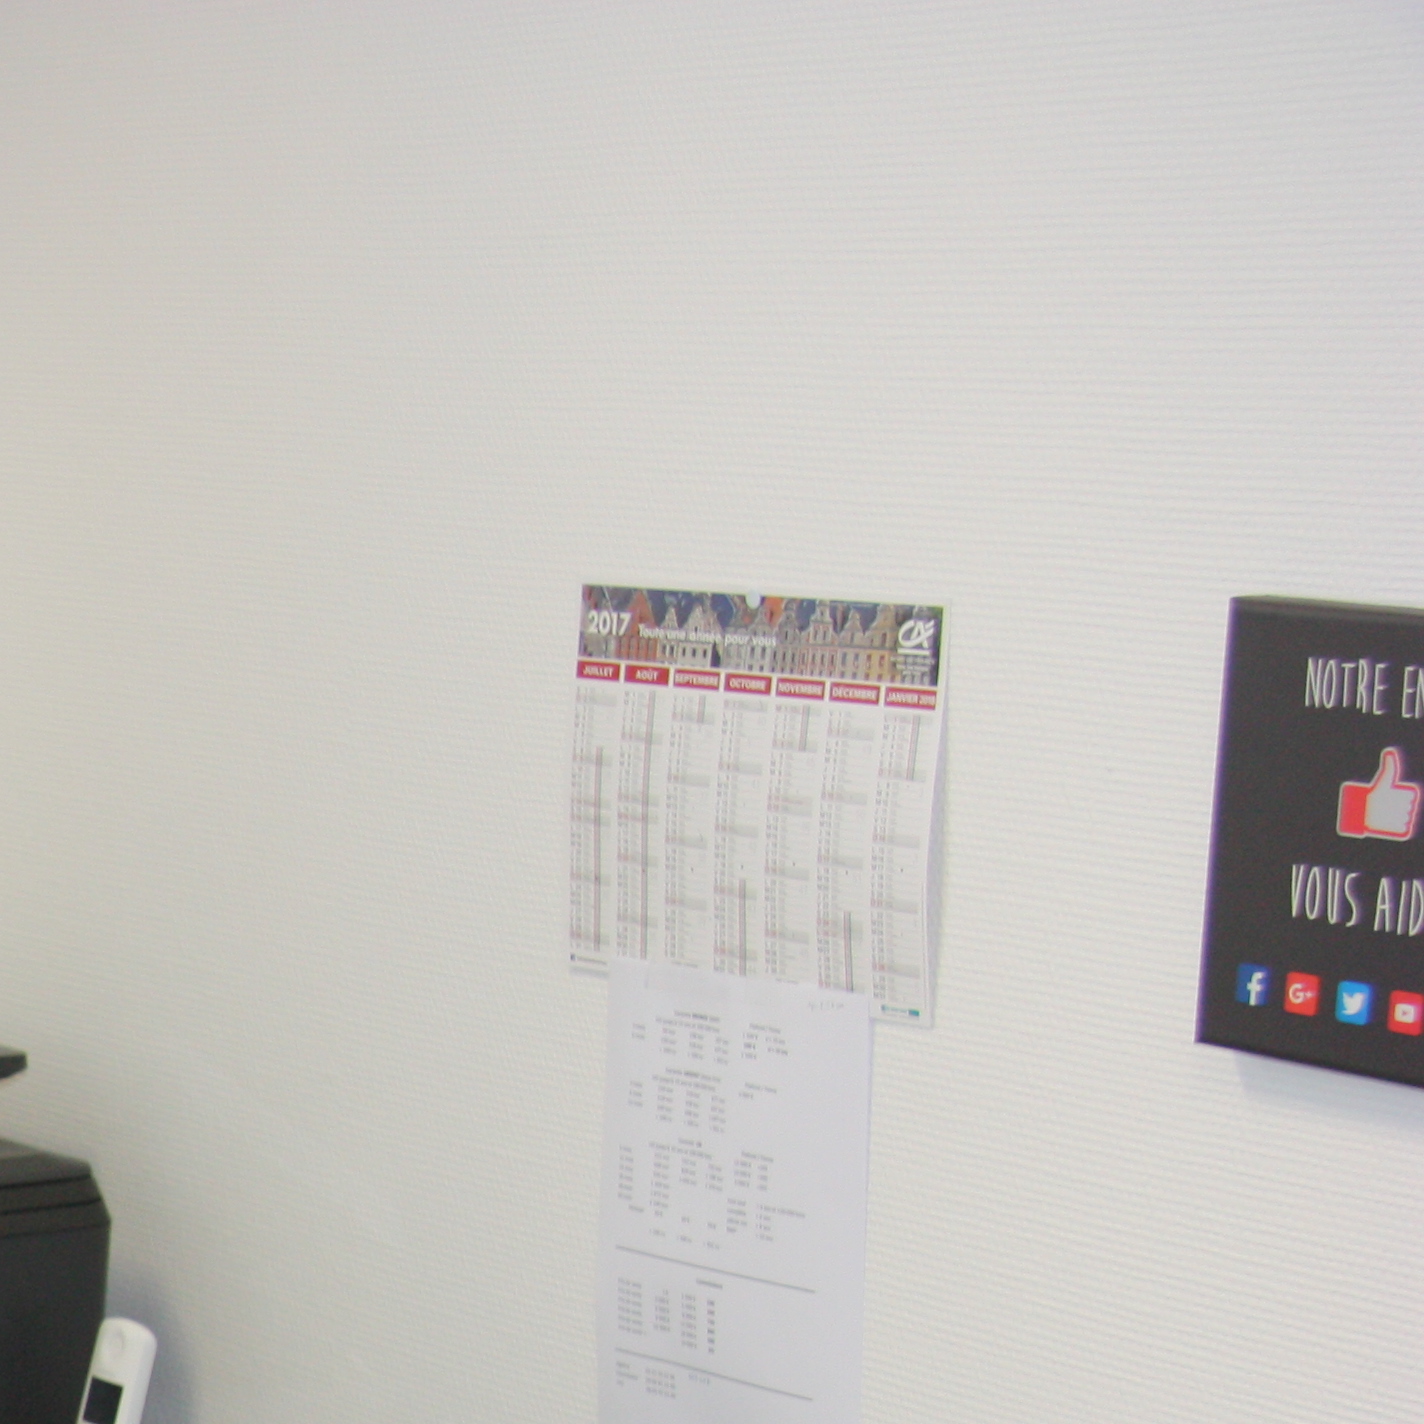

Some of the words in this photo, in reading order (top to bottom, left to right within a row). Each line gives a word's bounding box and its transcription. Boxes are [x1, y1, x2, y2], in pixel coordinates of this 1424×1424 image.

[587, 610, 632, 637] 2017
[724, 633, 749, 646] pour
[751, 635, 777, 647] vous
[583, 665, 614, 678] JUILLET
[675, 673, 719, 686] SEPTEMBRE
[729, 679, 767, 692] OCTOBRE
[778, 683, 823, 696] NOVEMBRE
[887, 692, 918, 704] JANVIER
[1304, 656, 1388, 716] NOTRE
[1291, 863, 1360, 929] VOUS
